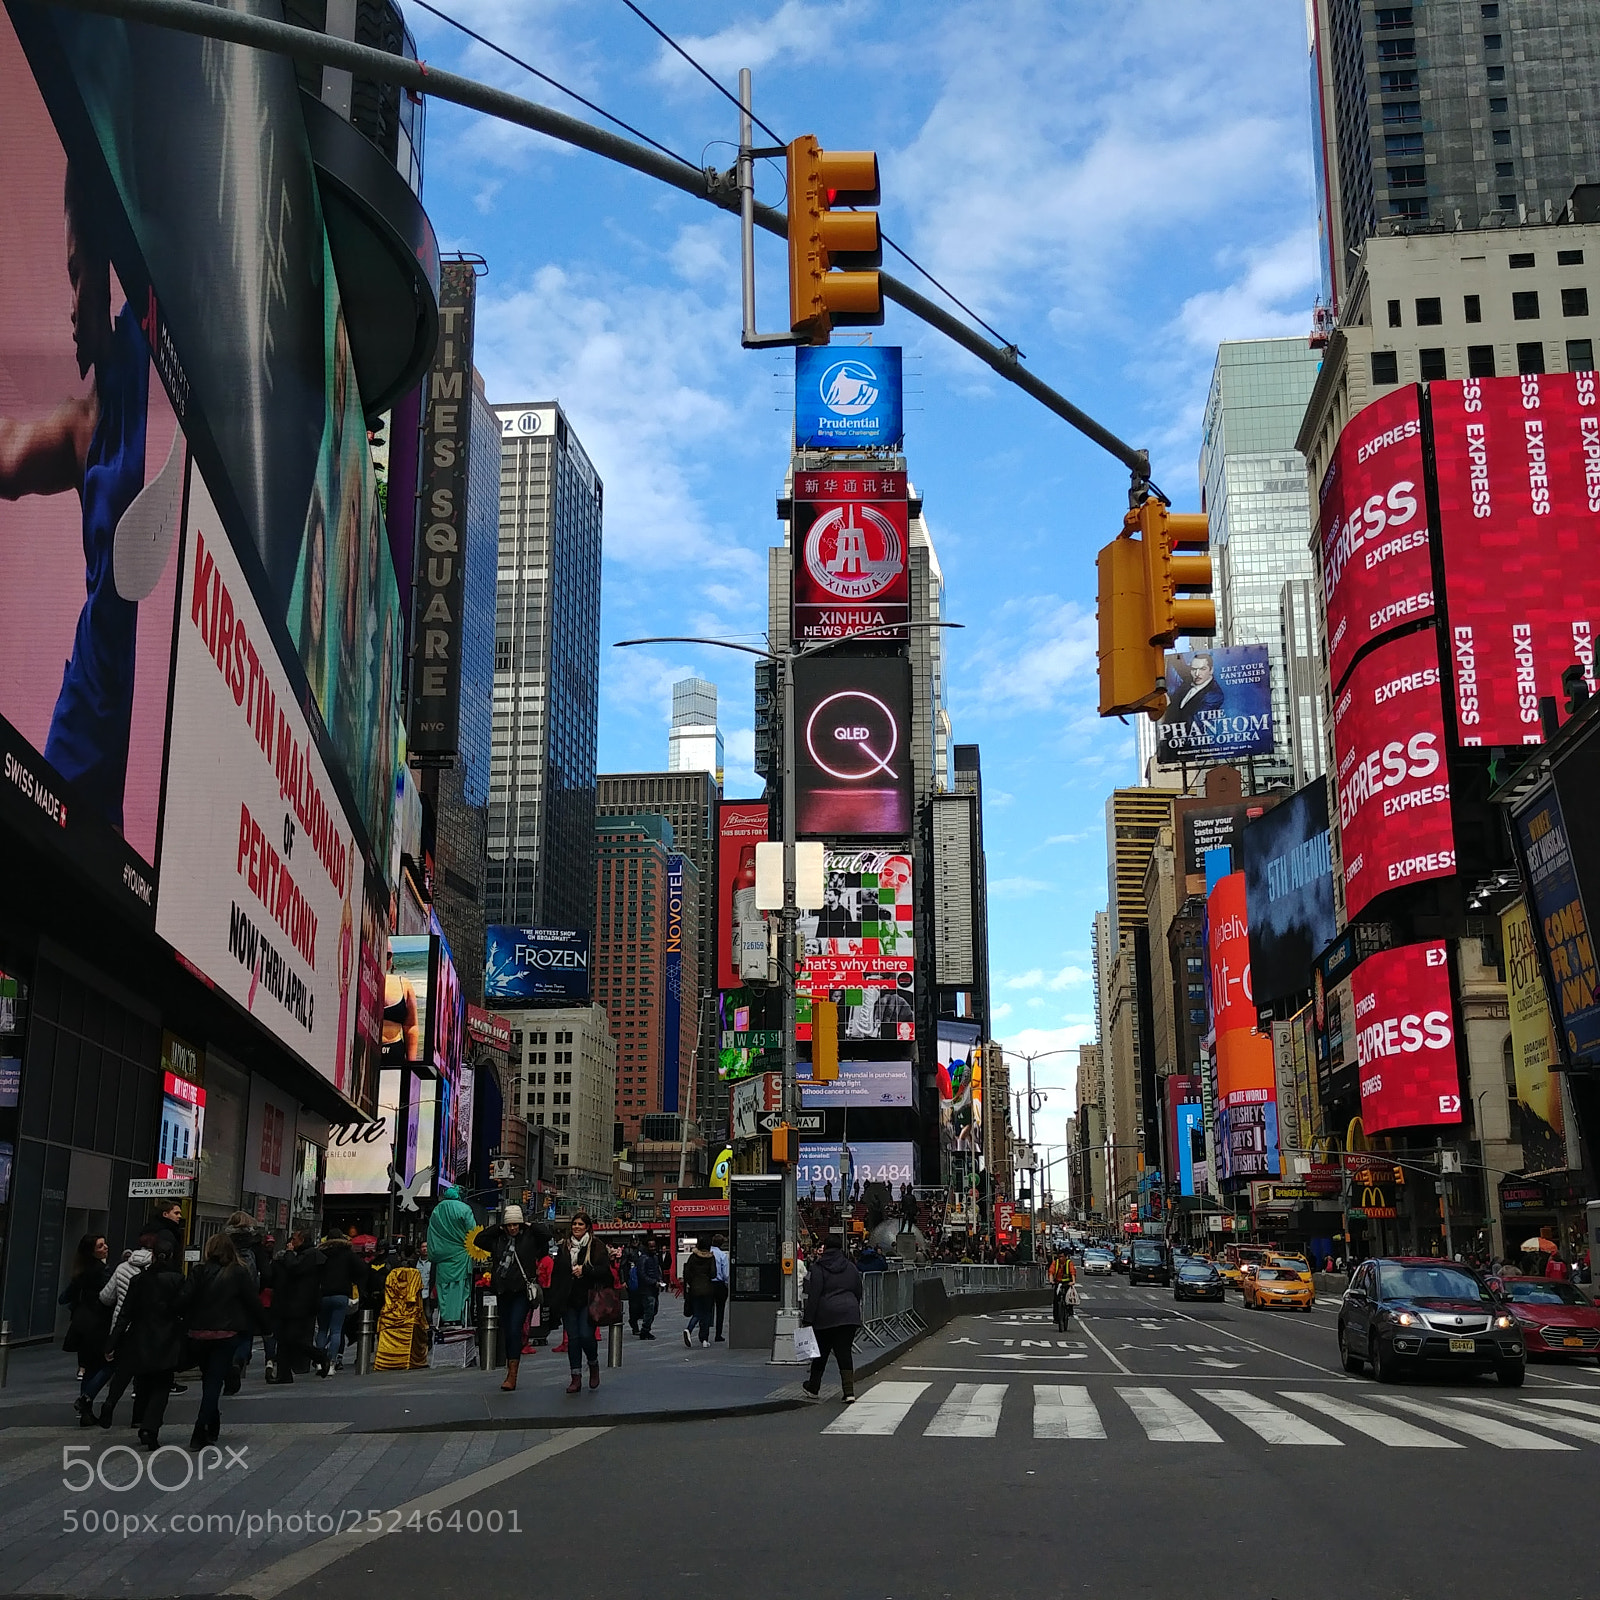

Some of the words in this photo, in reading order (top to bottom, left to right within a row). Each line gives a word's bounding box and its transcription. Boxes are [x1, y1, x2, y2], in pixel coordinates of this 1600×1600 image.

[161, 322, 192, 399] MARRIOTT
[160, 348, 186, 417] MARQUIS
[432, 306, 465, 468] TIMES
[818, 417, 880, 429] Prudential
[1467, 424, 1491, 519] EXPRESS
[1525, 420, 1550, 516] EXPRESS
[1580, 417, 1600, 513] EXPRESS
[804, 479, 896, 494] 新华通讯社
[1325, 480, 1417, 604] EXPRESS
[422, 488, 458, 697] SQUARE
[826, 578, 882, 596] XINHUA
[804, 626, 842, 636] NEWS
[819, 611, 885, 625] XINHUA
[1220, 669, 1266, 680] FANTASIES
[1226, 676, 1260, 686] UNWIND
[1454, 626, 1480, 726] EXPRESS
[1513, 624, 1538, 724] EXPRESS
[192, 529, 276, 766] KIRSTIN
[275, 706, 346, 901] MALDONADO
[1198, 708, 1226, 720] THE
[420, 722, 445, 733] NYC
[834, 728, 870, 740] QLED
[1159, 714, 1270, 741] PHANTOM
[1168, 738, 1187, 749] OF
[1188, 735, 1216, 748] THE
[1216, 731, 1260, 745] OPERA
[4, 752, 34, 798] SWISS
[34, 779, 60, 822] MADE
[1340, 732, 1440, 831] EXPRESS
[1194, 820, 1214, 828] Show
[1215, 816, 1234, 826] your
[1194, 828, 1214, 836] taste
[1214, 826, 1234, 834] buds
[283, 812, 296, 860] OF
[1194, 844, 1214, 854] good
[1200, 835, 1224, 844] berry
[1268, 853, 1289, 902] 5TH
[1291, 828, 1333, 891] AVENUE
[238, 801, 318, 971] PENTATONIX
[667, 866, 682, 953] NOVOTEL
[1544, 899, 1586, 949] COME
[515, 944, 586, 970] FROZEN
[743, 942, 764, 950] 726159
[228, 899, 258, 979] NOW
[259, 944, 285, 999] THRU
[285, 965, 308, 1028] APRIL
[308, 998, 314, 1034] 8
[840, 958, 868, 972] why
[872, 958, 908, 970] there
[1356, 993, 1376, 1020] EXPRESS
[736, 1034, 748, 1046] W
[752, 1033, 766, 1046] 45
[770, 1032, 778, 1042] St
[1356, 1011, 1452, 1068] EXPRESS
[1524, 1036, 1548, 1055] BROADWAY
[1524, 1052, 1540, 1068] SPRING
[1279, 1032, 1298, 1148] PALACE
[1362, 1074, 1382, 1098] EXPRESS
[1000, 1206, 1012, 1230] tkts
[947, 1336, 1088, 1350] ONLY
